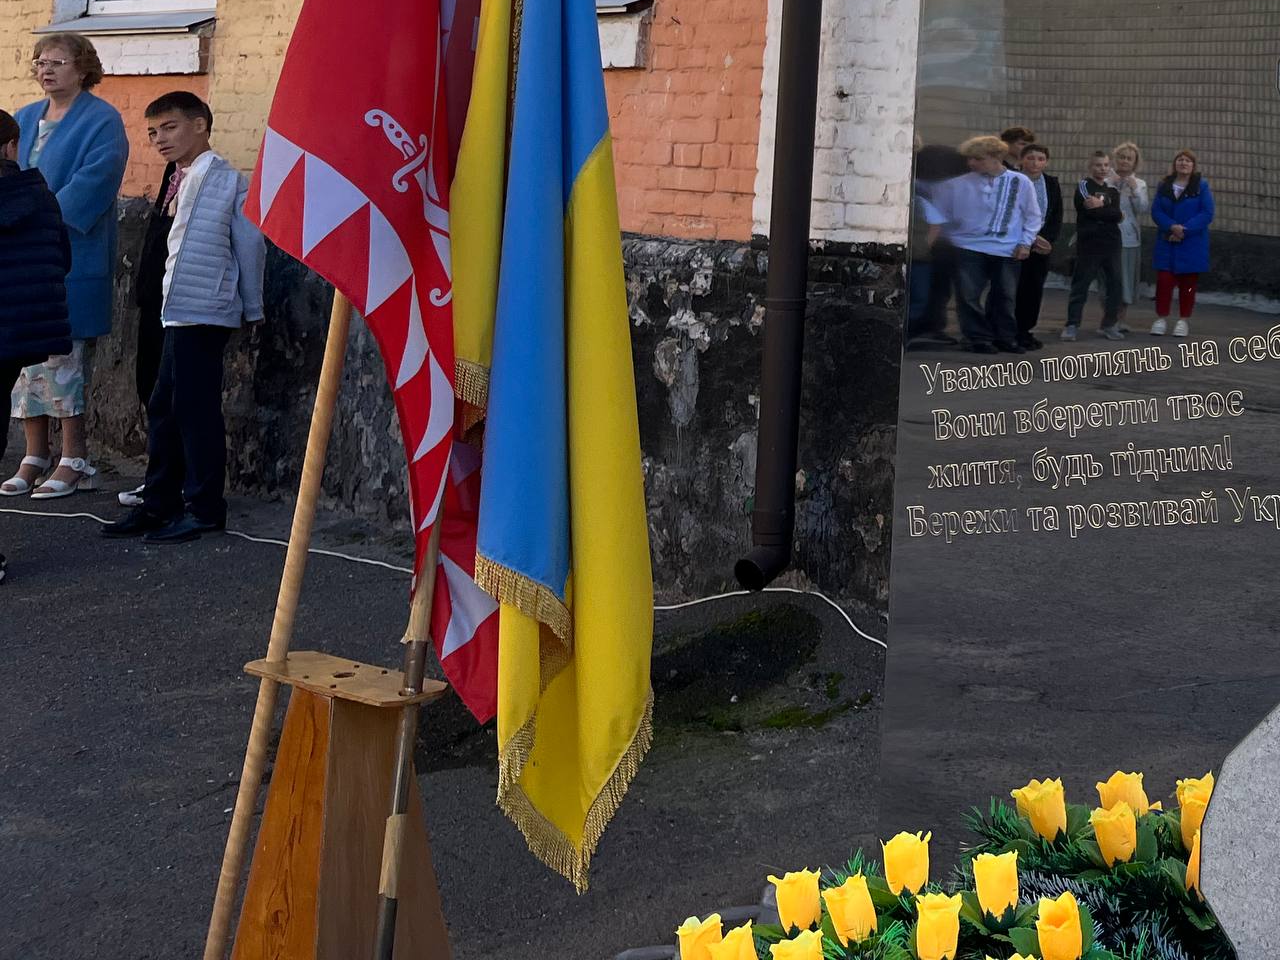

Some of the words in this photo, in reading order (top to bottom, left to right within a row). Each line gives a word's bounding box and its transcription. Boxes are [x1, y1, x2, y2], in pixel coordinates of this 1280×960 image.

[920, 359, 1033, 396] Уважно
[1040, 347, 1172, 384] поглянь
[1180, 340, 1219, 368] на
[932, 408, 1006, 441] Вони
[1013, 397, 1159, 437] вберегли
[1167, 390, 1245, 421] твоє
[927, 457, 1023, 489] життя,
[1031, 447, 1104, 488] будь
[1110, 435, 1233, 482] гідним!
[907, 503, 1019, 543] Бережи
[1027, 504, 1059, 532] та
[1066, 490, 1219, 538] розвивай
